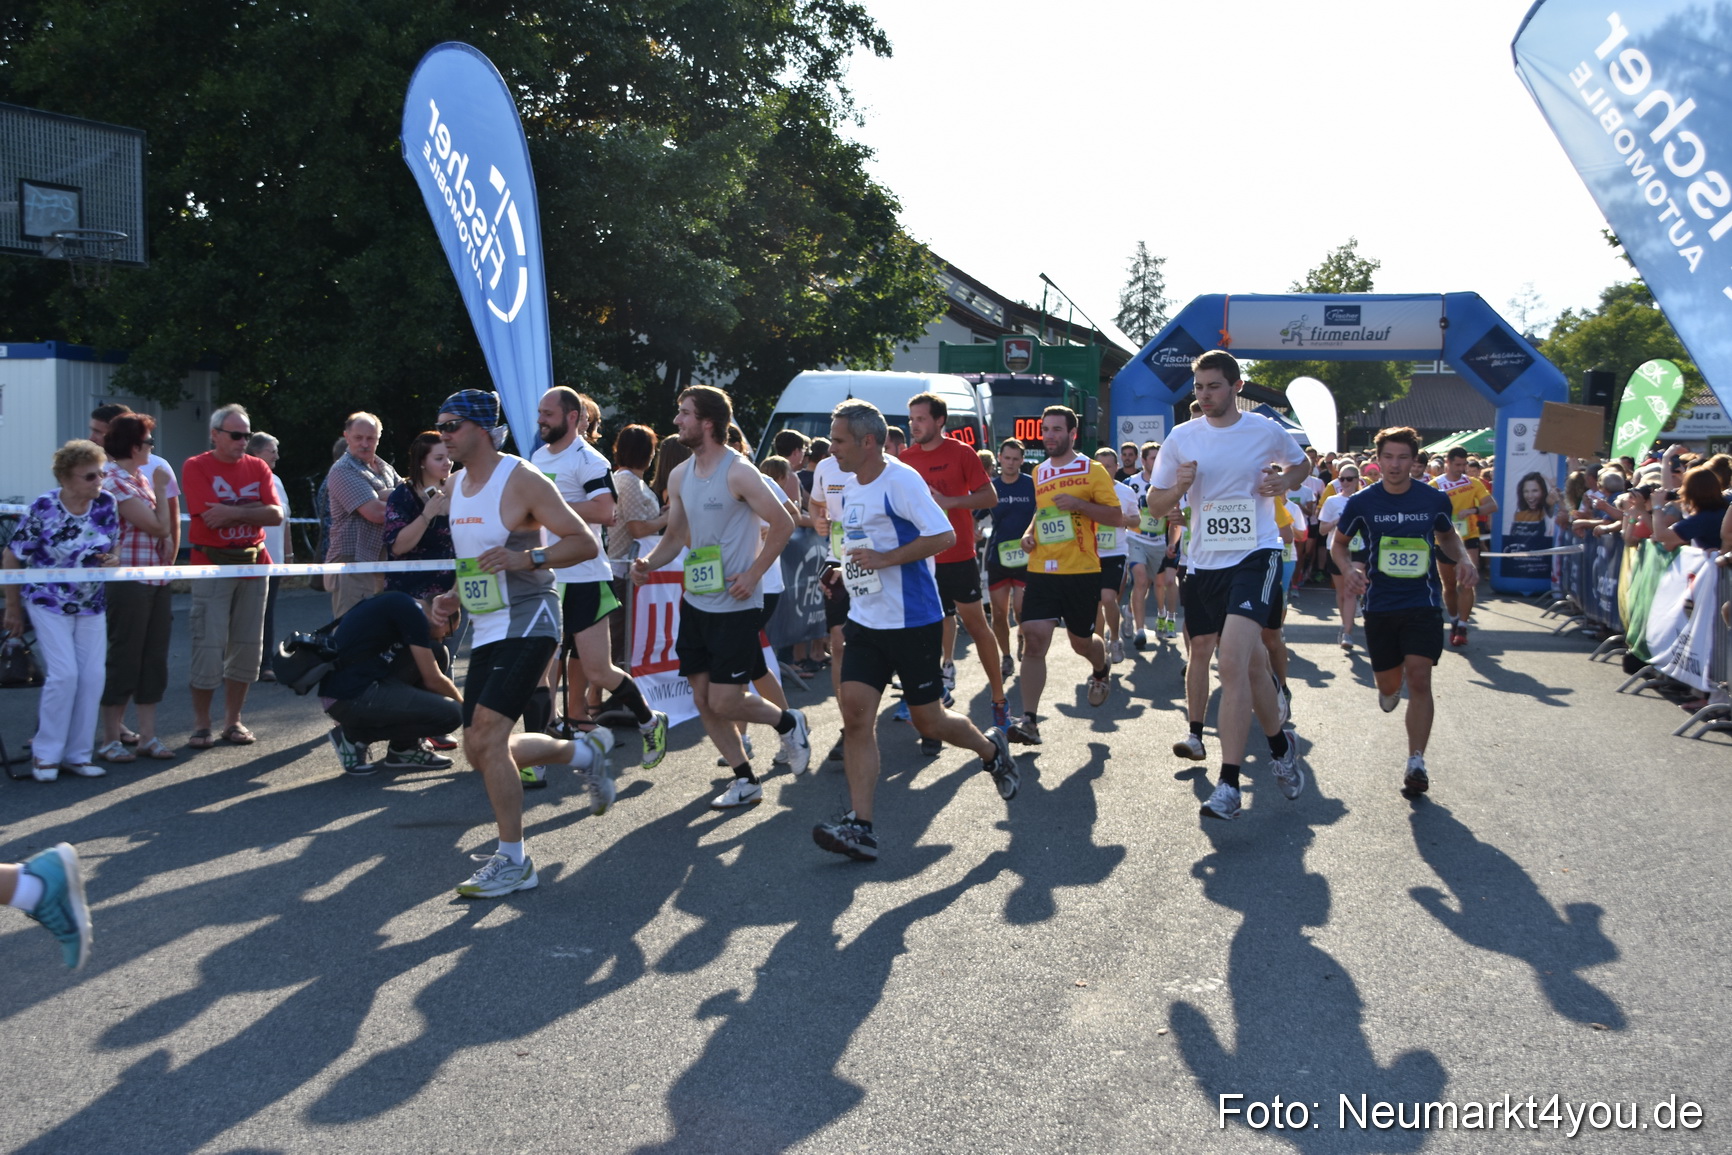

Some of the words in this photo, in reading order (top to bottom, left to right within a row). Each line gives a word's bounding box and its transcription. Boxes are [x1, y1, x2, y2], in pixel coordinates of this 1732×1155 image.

[1311, 326, 1392, 341] firmenlauf
[1160, 353, 1198, 363] Fische
[1616, 414, 1647, 446] AOK
[1036, 483, 1057, 497] MAX
[1059, 476, 1090, 489] BÖGL
[1203, 503, 1248, 512] df-sports
[1374, 514, 1397, 523] EURO
[1405, 512, 1429, 522] POLES
[1042, 520, 1066, 535] 905
[1207, 516, 1251, 535] 8933
[1005, 550, 1025, 562] 379
[1388, 553, 1419, 567] 382
[692, 565, 715, 583] 351
[464, 580, 489, 600] 587
